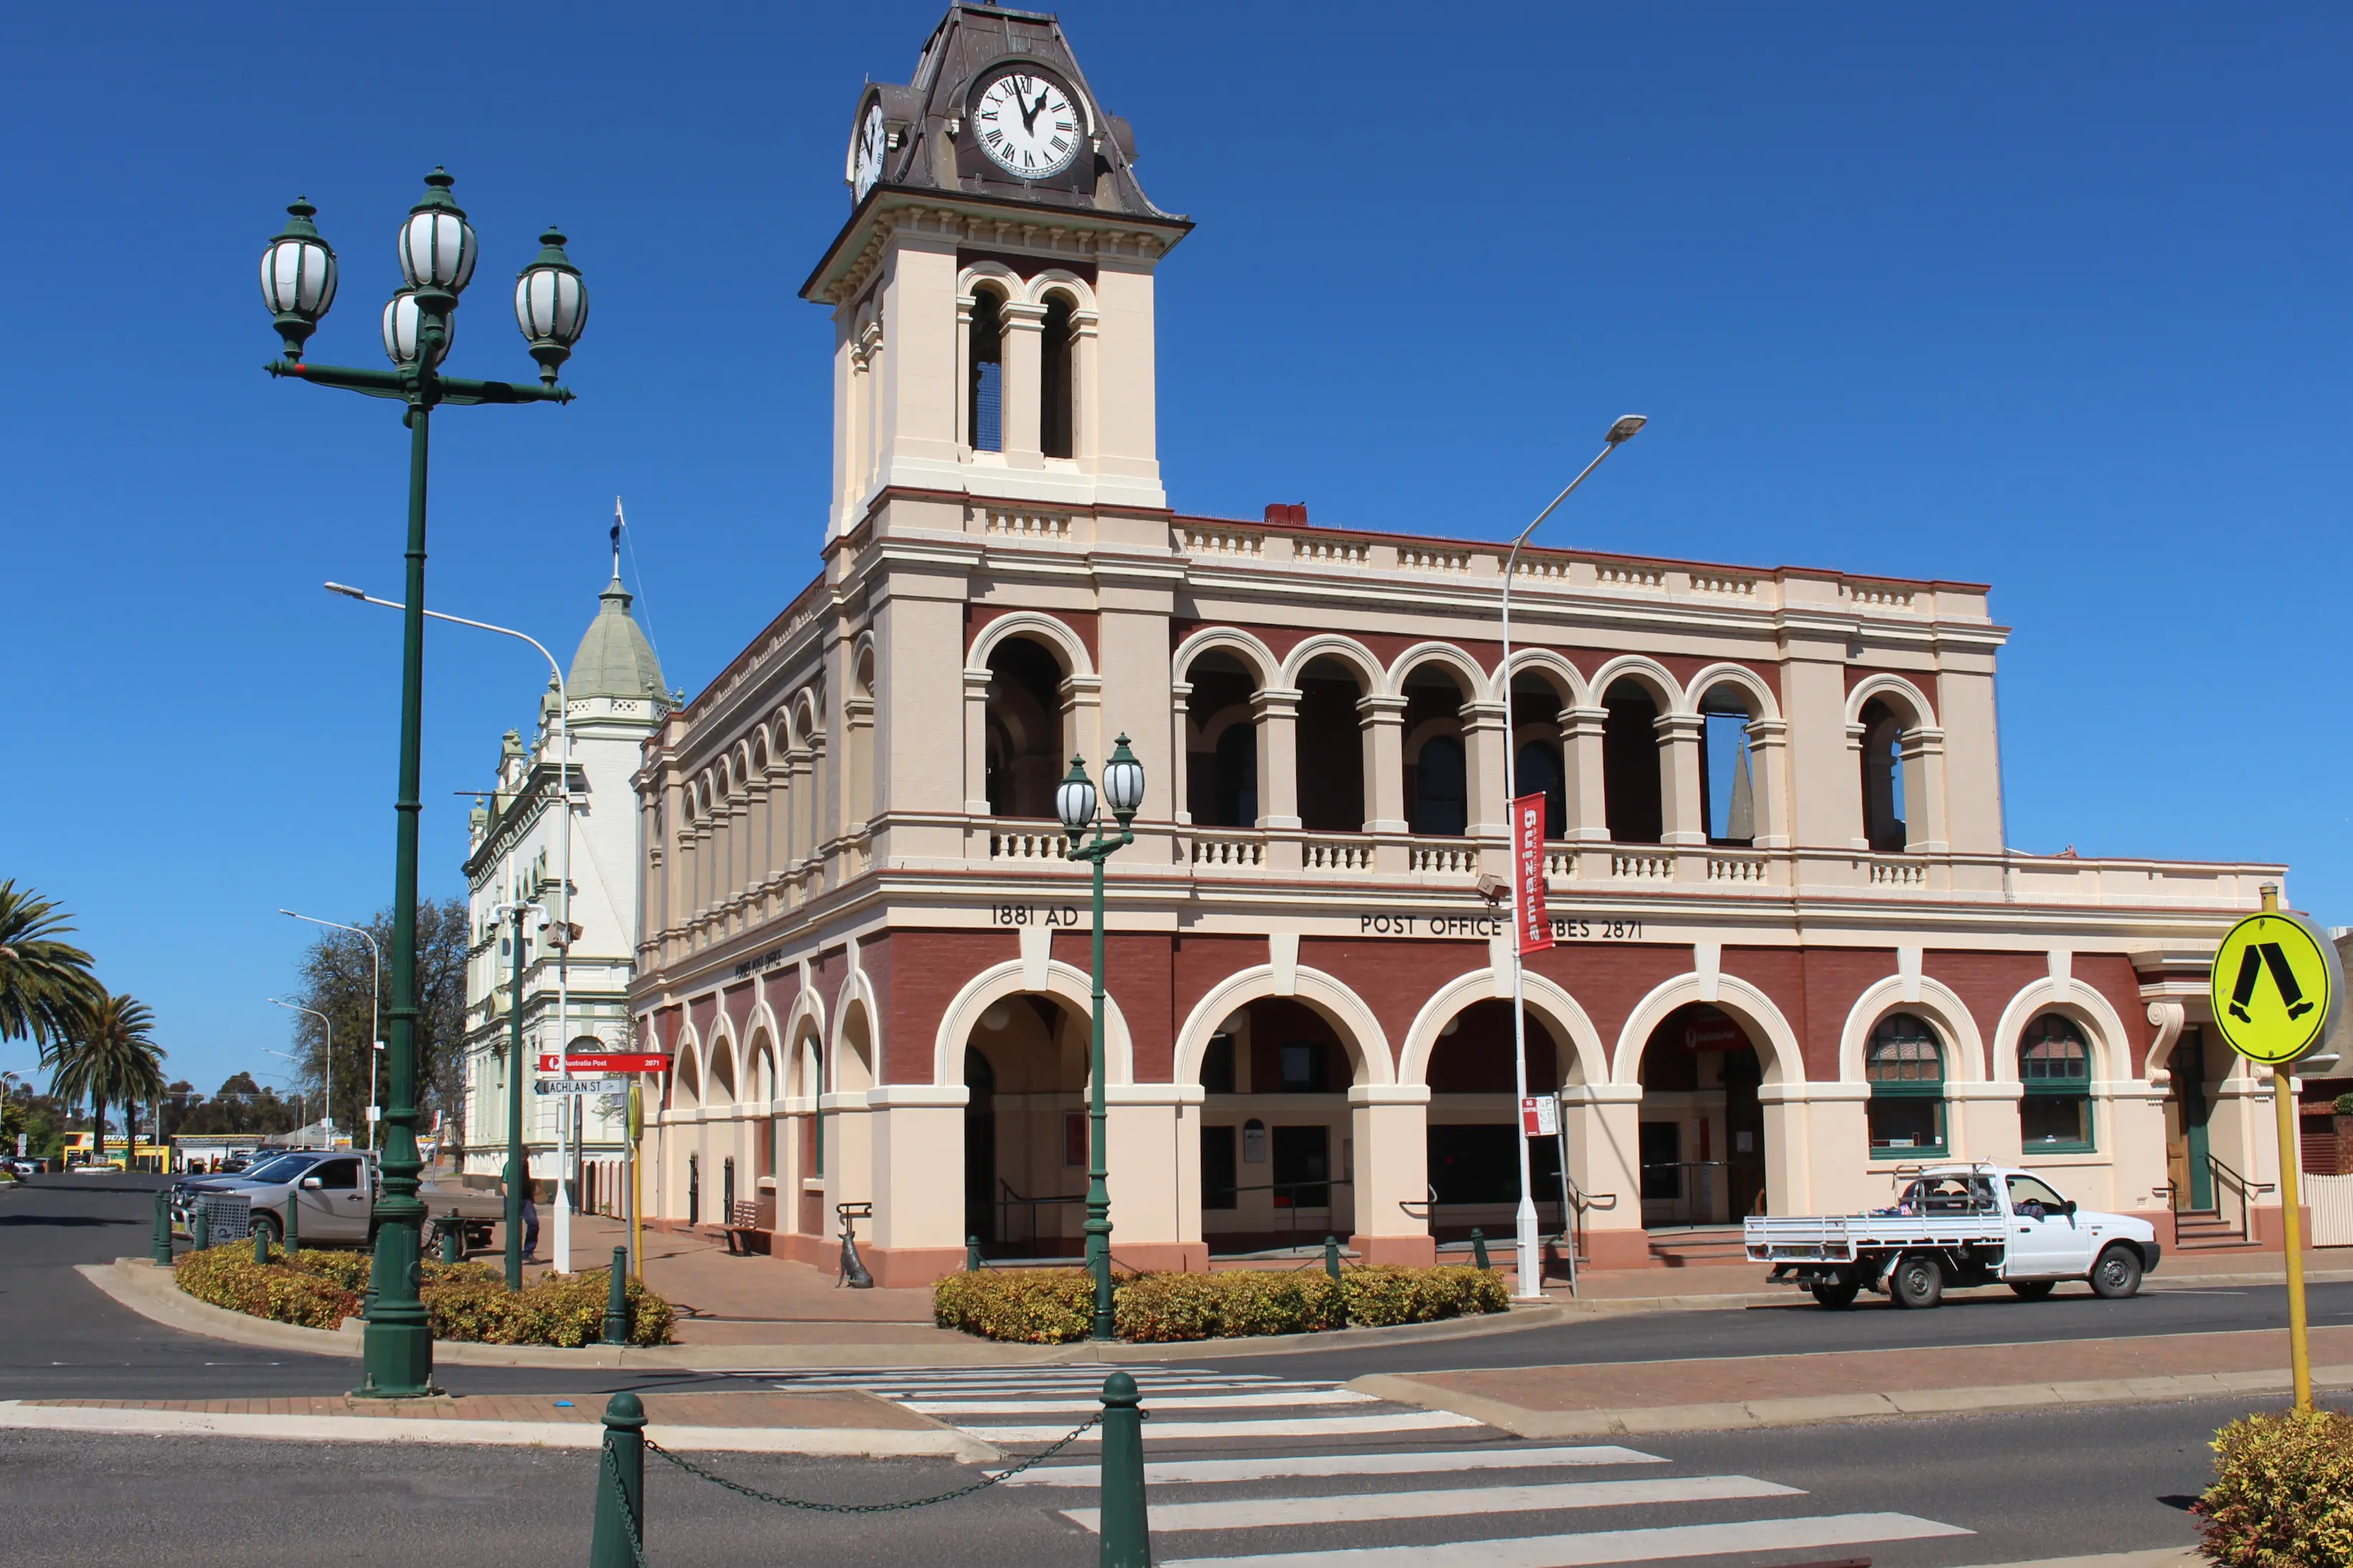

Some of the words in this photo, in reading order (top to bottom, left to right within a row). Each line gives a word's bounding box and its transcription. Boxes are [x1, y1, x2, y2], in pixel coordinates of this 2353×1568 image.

[1522, 808, 1540, 941] amazing
[993, 905, 1034, 925] 1881
[1045, 906, 1078, 925] AD
[1361, 914, 1417, 934] POST
[1429, 915, 1502, 936] OFFICE
[1601, 920, 1642, 938] 2871
[543, 1081, 588, 1093] LACHLAN
[590, 1081, 601, 1092] ST
